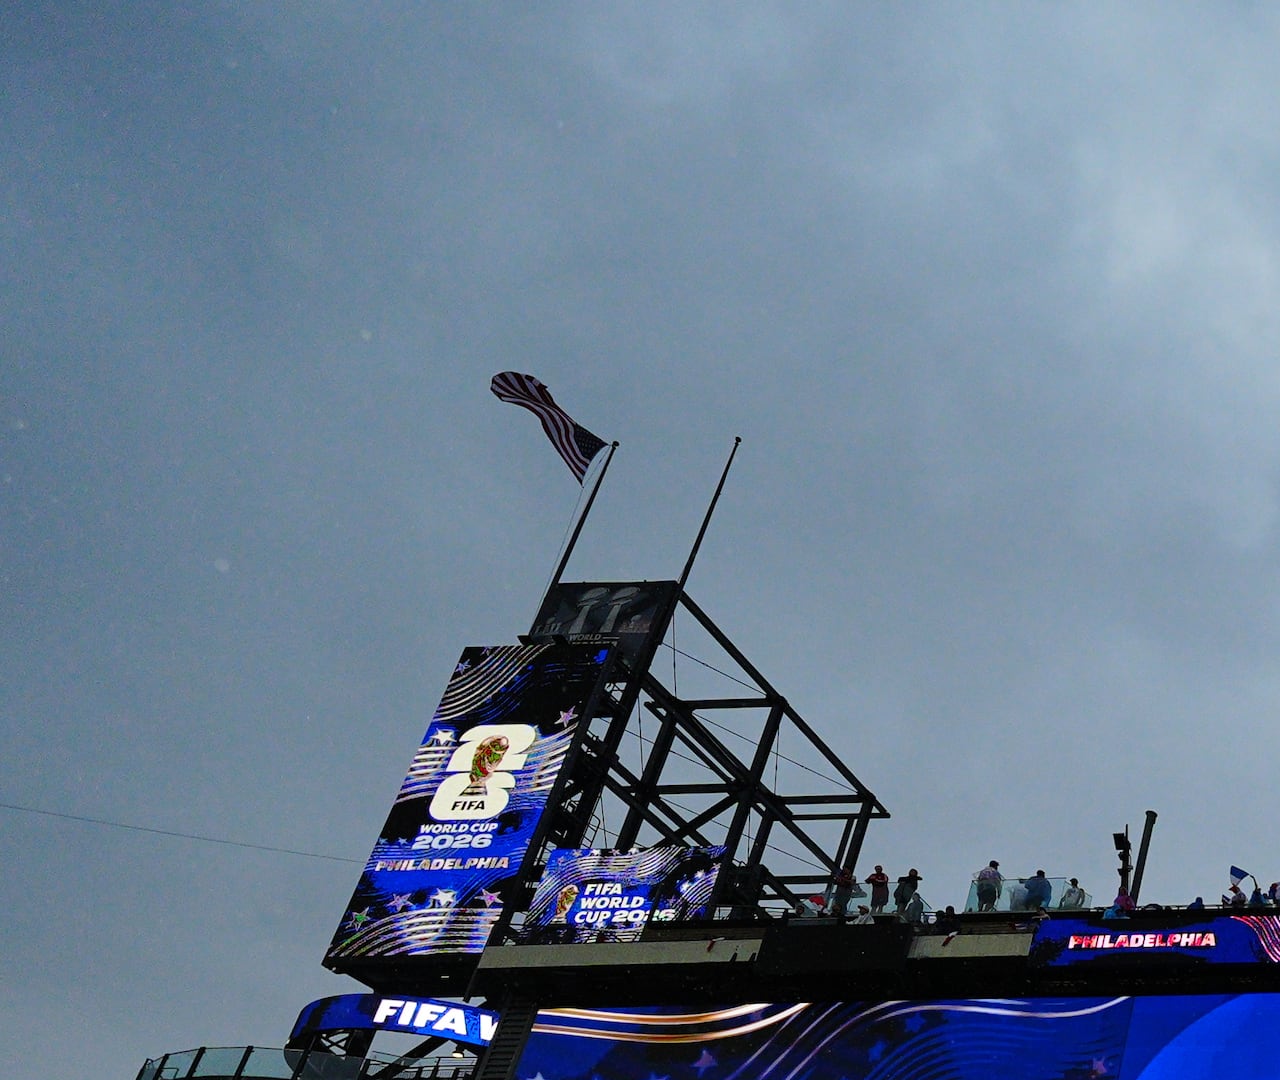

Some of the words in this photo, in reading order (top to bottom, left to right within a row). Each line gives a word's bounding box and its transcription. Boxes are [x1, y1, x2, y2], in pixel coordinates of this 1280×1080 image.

[451, 800, 485, 811] FIFA
[420, 823, 468, 834] WORLD
[470, 822, 498, 833] CUP
[411, 833, 493, 850] 2026
[375, 856, 509, 872] PHILADELPHIA
[584, 883, 622, 896] FIFA
[580, 896, 645, 909] WORLD
[574, 910, 611, 924] CUP
[1068, 932, 1216, 950] PHILADELPHIA
[373, 999, 468, 1036] FIFA
